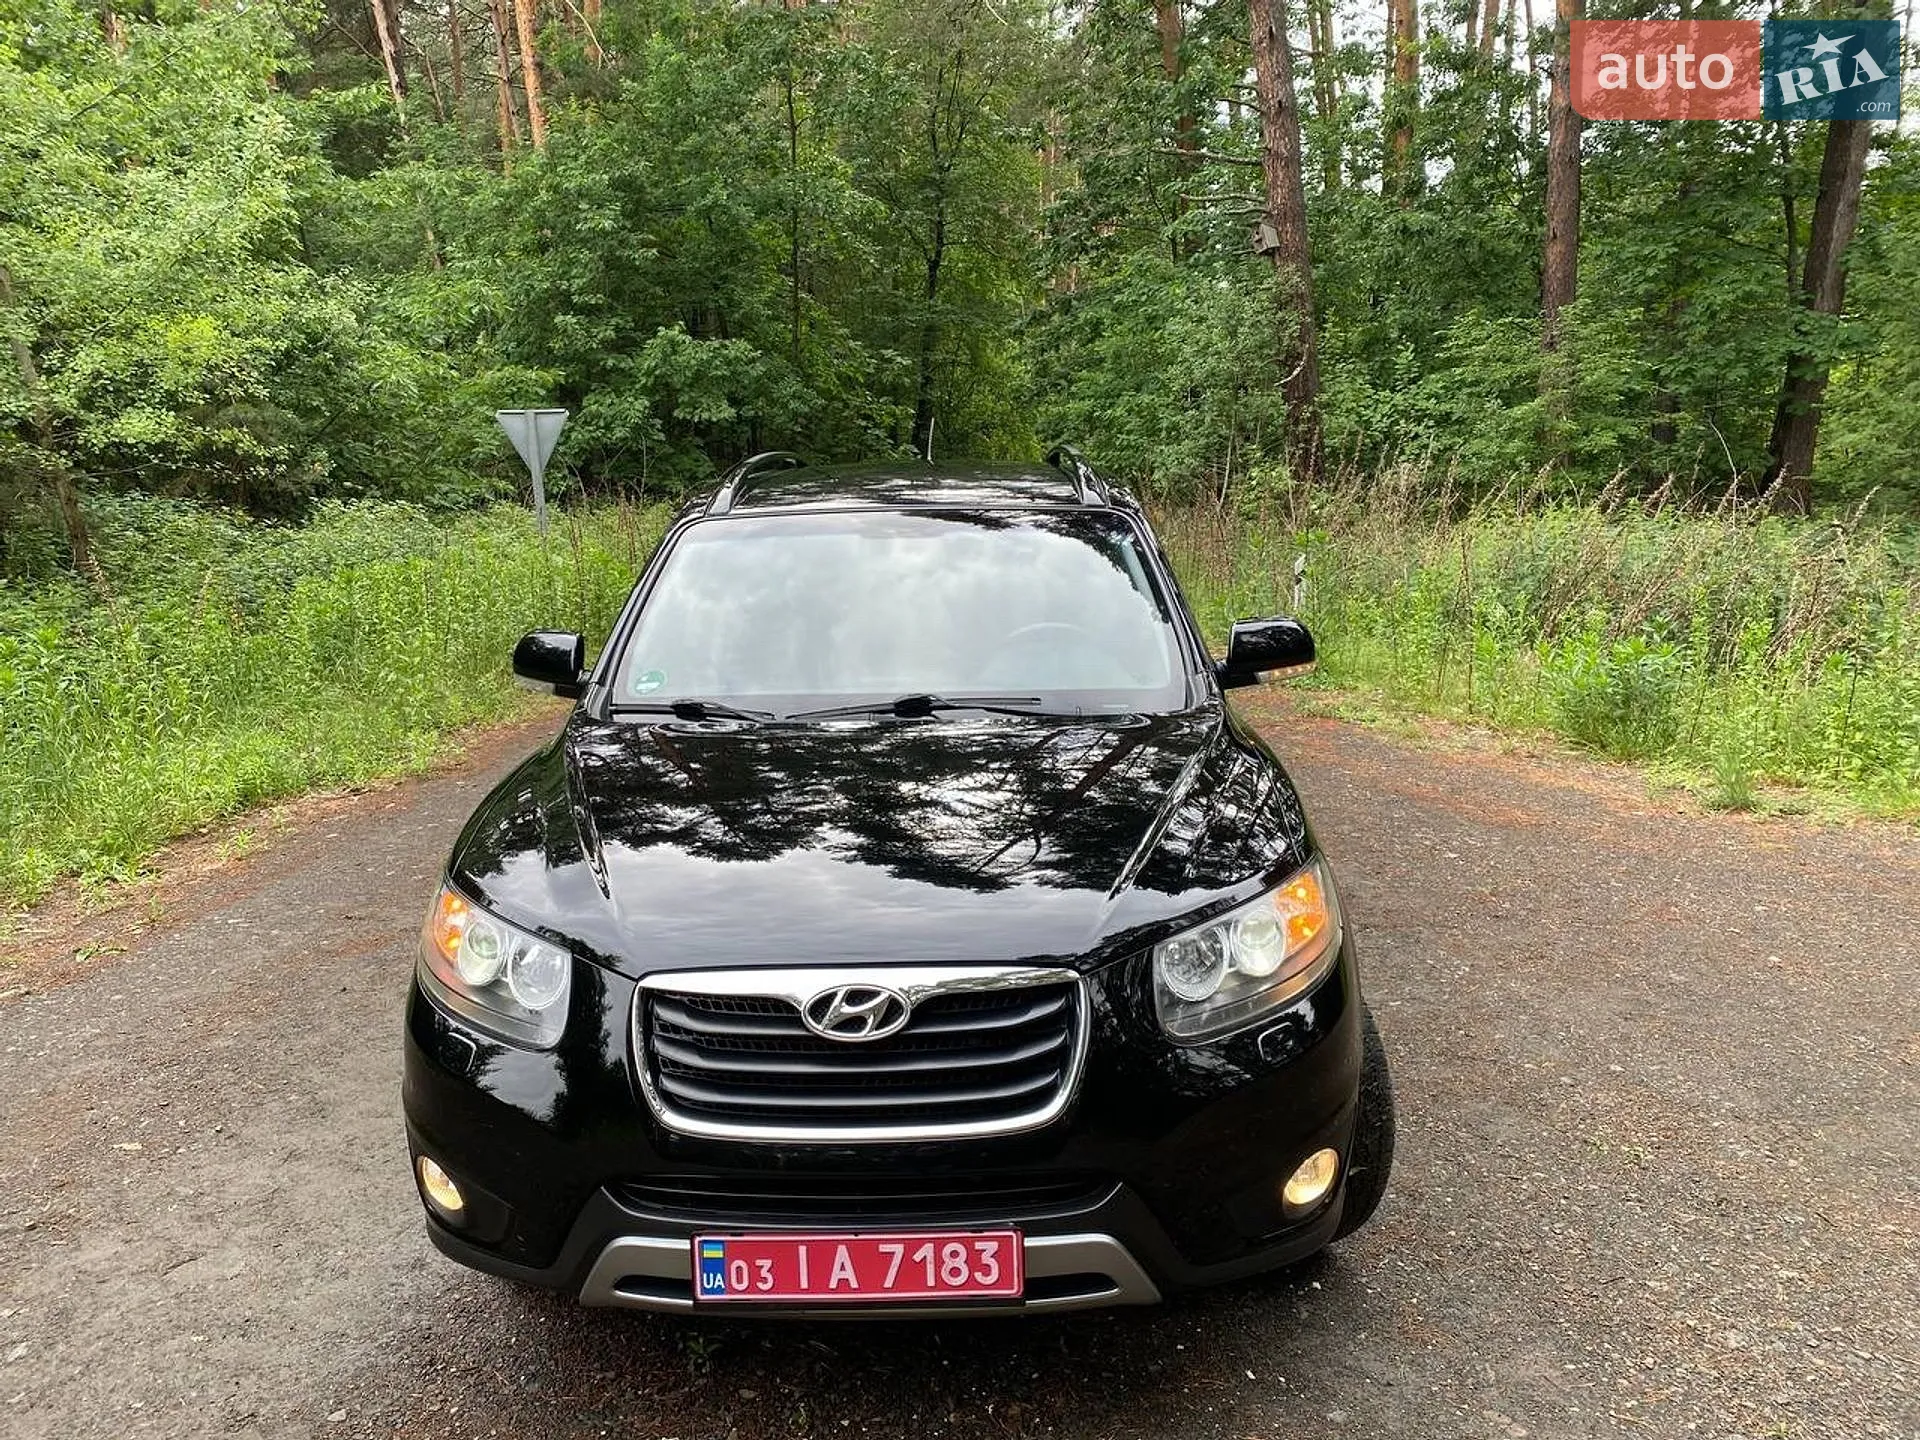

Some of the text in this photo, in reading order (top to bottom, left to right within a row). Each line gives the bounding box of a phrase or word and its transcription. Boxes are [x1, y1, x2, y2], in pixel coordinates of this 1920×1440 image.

[703, 1272, 725, 1289] UA
[730, 1259, 774, 1291] 03
[878, 1241, 1000, 1289] 7183
